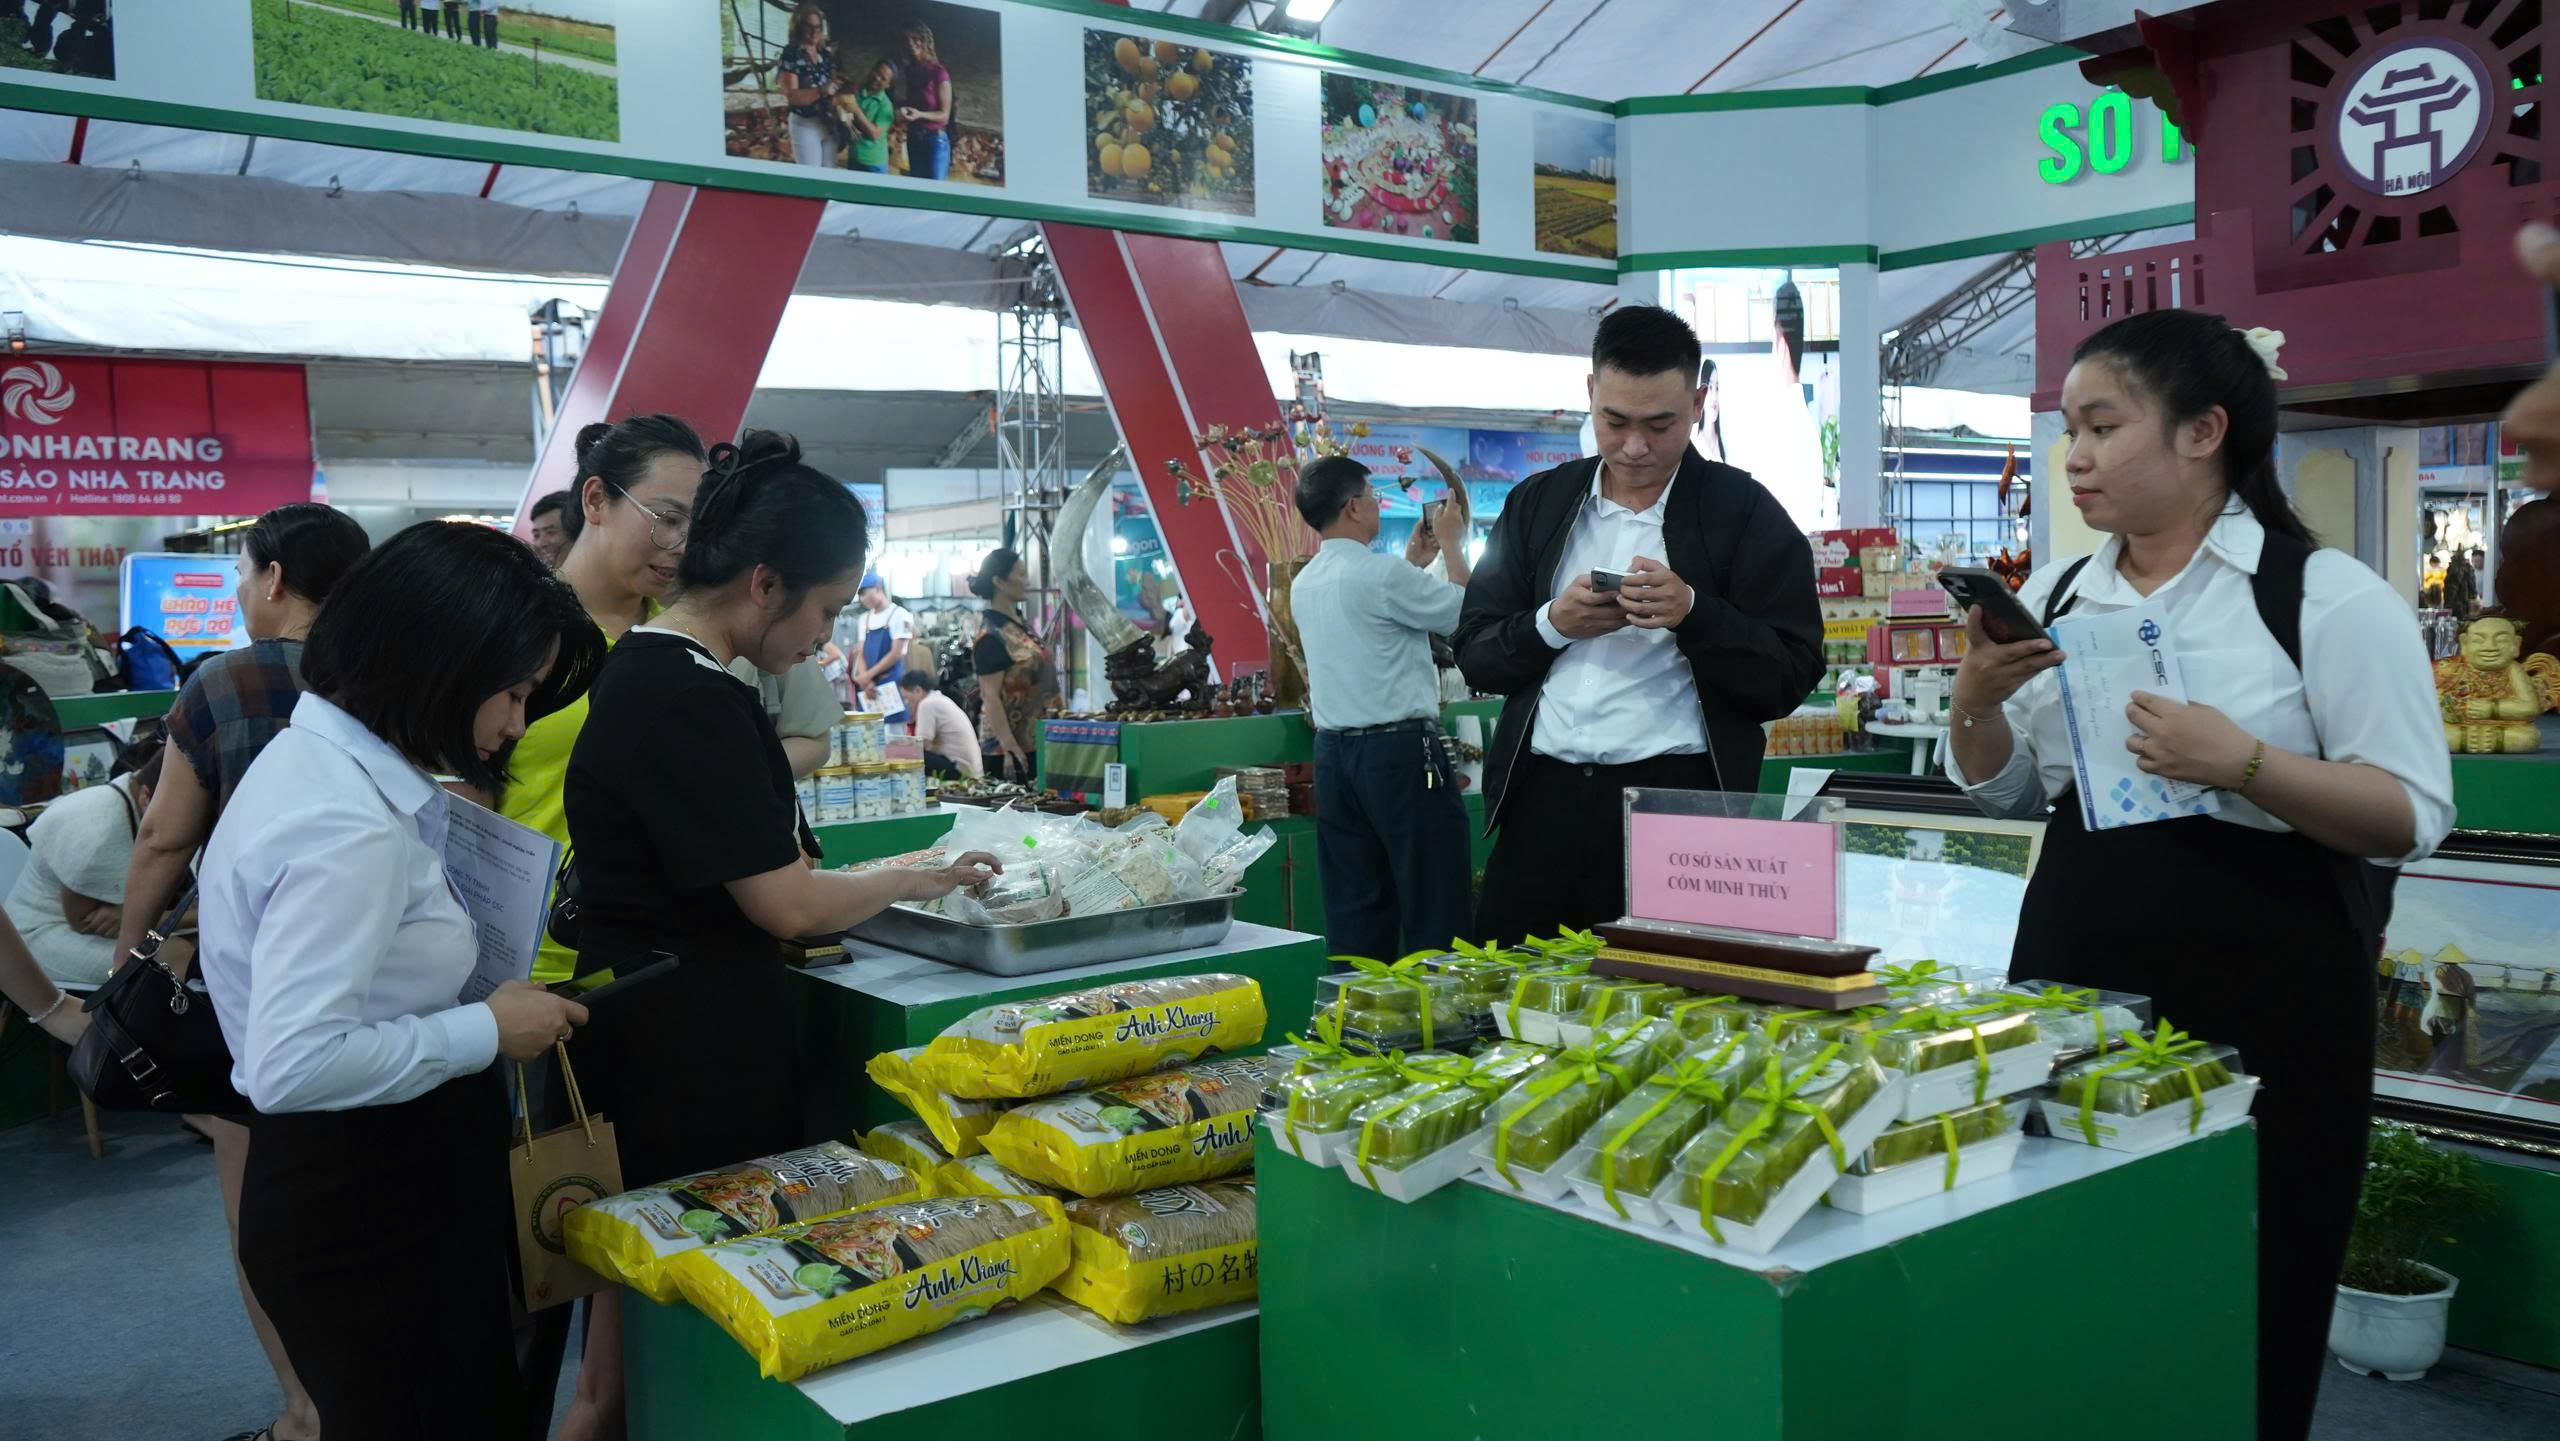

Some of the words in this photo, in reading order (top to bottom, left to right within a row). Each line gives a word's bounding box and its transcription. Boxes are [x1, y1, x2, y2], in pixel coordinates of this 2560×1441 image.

[2385, 175, 2404, 193] HÀ
[2407, 171, 2430, 190] NỘI
[68, 469, 129, 489] NHA
[136, 470, 225, 490] TRANG
[2152, 648, 2169, 687] CSC
[1669, 852, 1690, 867] CƠ
[1692, 851, 1712, 869] SỞ
[1714, 852, 1742, 871] SẢN
[1746, 856, 1788, 875] XUẤT
[1704, 879, 1744, 896] MINH
[1116, 1013, 1165, 1042] Anh
[1165, 1006, 1221, 1037] Khang
[1074, 1031, 1104, 1045] DONG
[1192, 1122, 1243, 1156] Anh
[1150, 1144, 1181, 1161] DONG
[905, 1268, 959, 1309] Anh
[959, 1255, 1017, 1288] Khang
